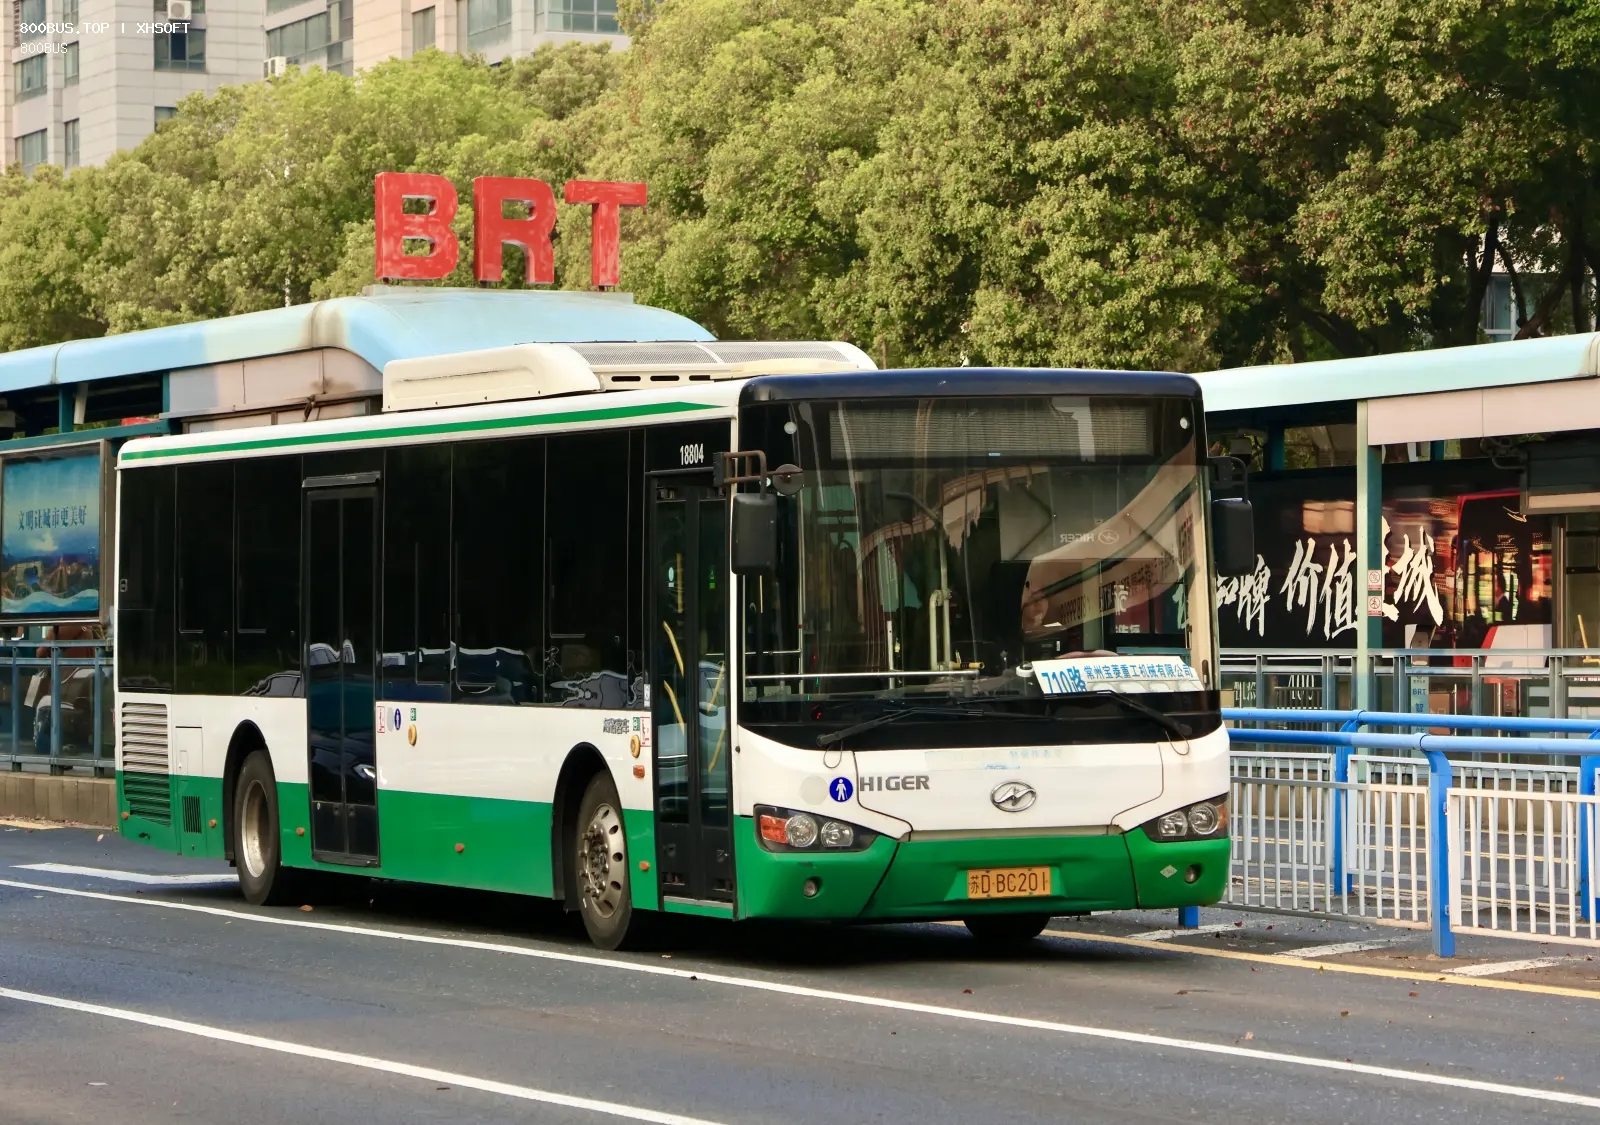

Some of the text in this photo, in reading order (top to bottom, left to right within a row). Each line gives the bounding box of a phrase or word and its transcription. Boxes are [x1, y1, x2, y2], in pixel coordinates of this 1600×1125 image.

[375, 172, 647, 286] BRT
[680, 443, 704, 466] 18804
[17, 505, 87, 531] 文明让城市更美好
[859, 775, 930, 793] HIGER
